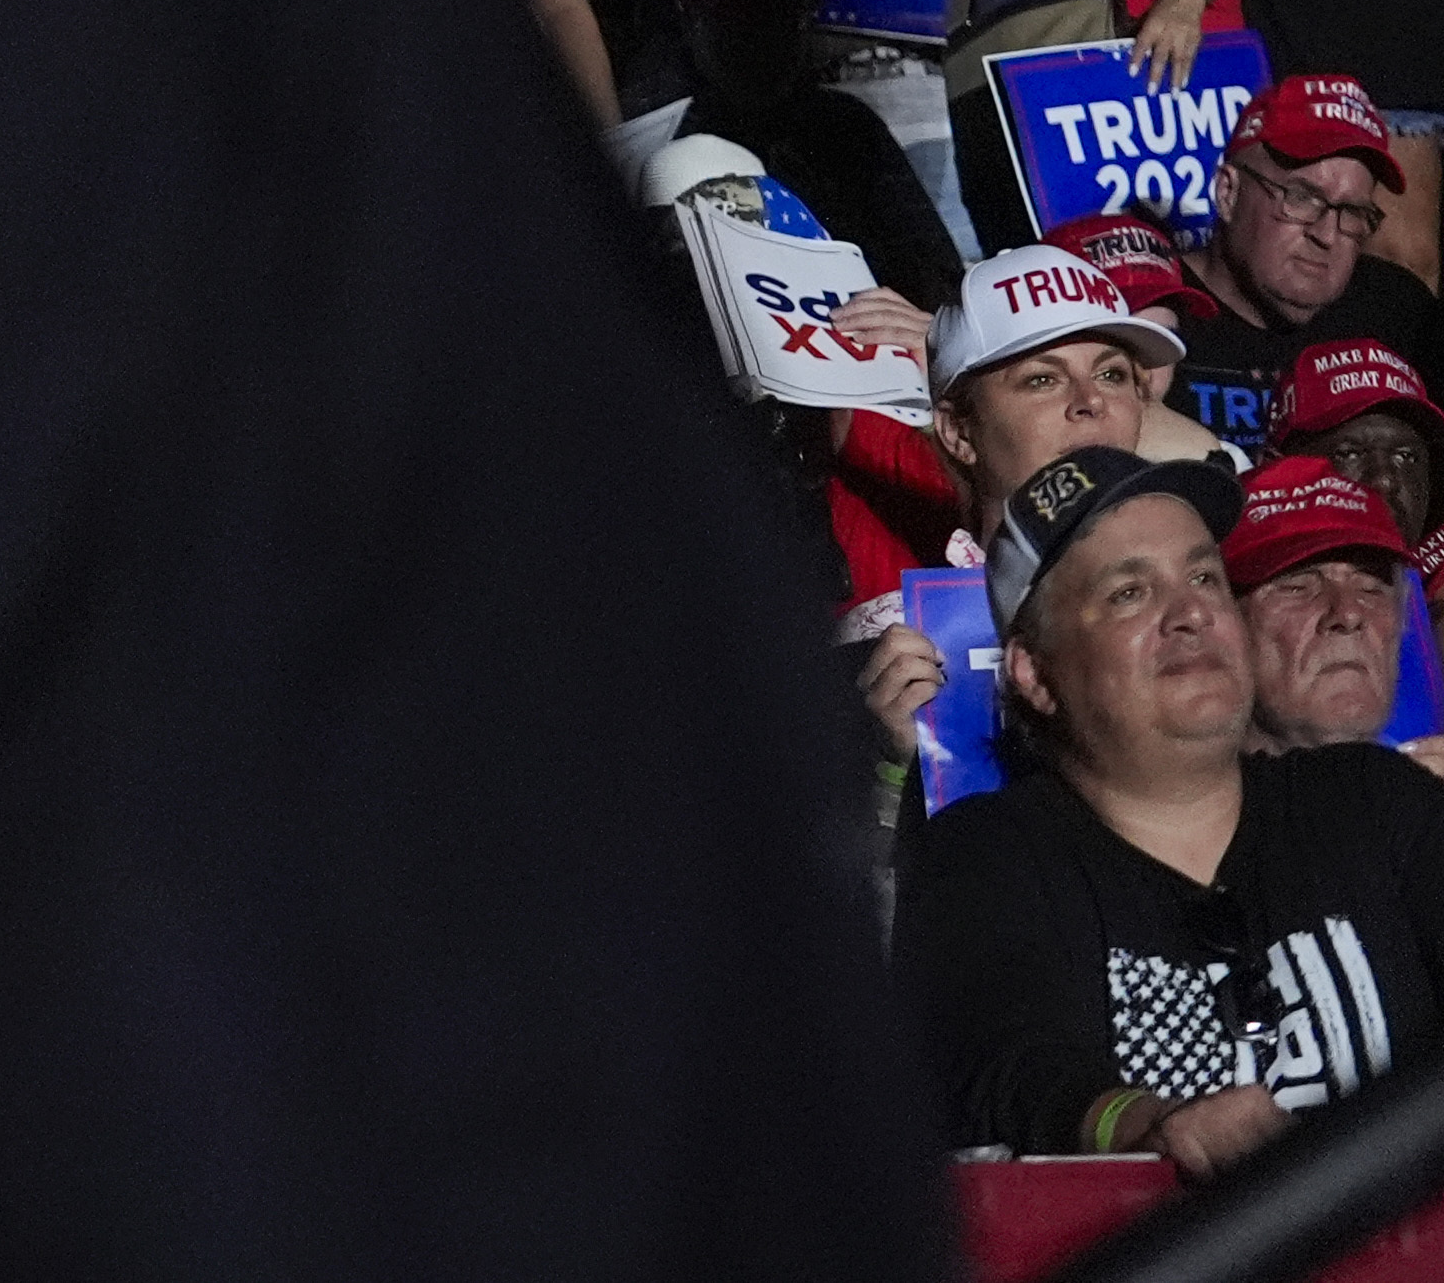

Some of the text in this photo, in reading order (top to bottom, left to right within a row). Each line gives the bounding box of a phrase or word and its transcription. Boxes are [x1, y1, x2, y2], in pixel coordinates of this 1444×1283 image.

[1043, 84, 1253, 165] TRUMP
[1095, 154, 1224, 217] 202
[993, 266, 1120, 315] TRUMP
[1313, 347, 1364, 374] MAKE
[1329, 369, 1380, 396] GREAT
